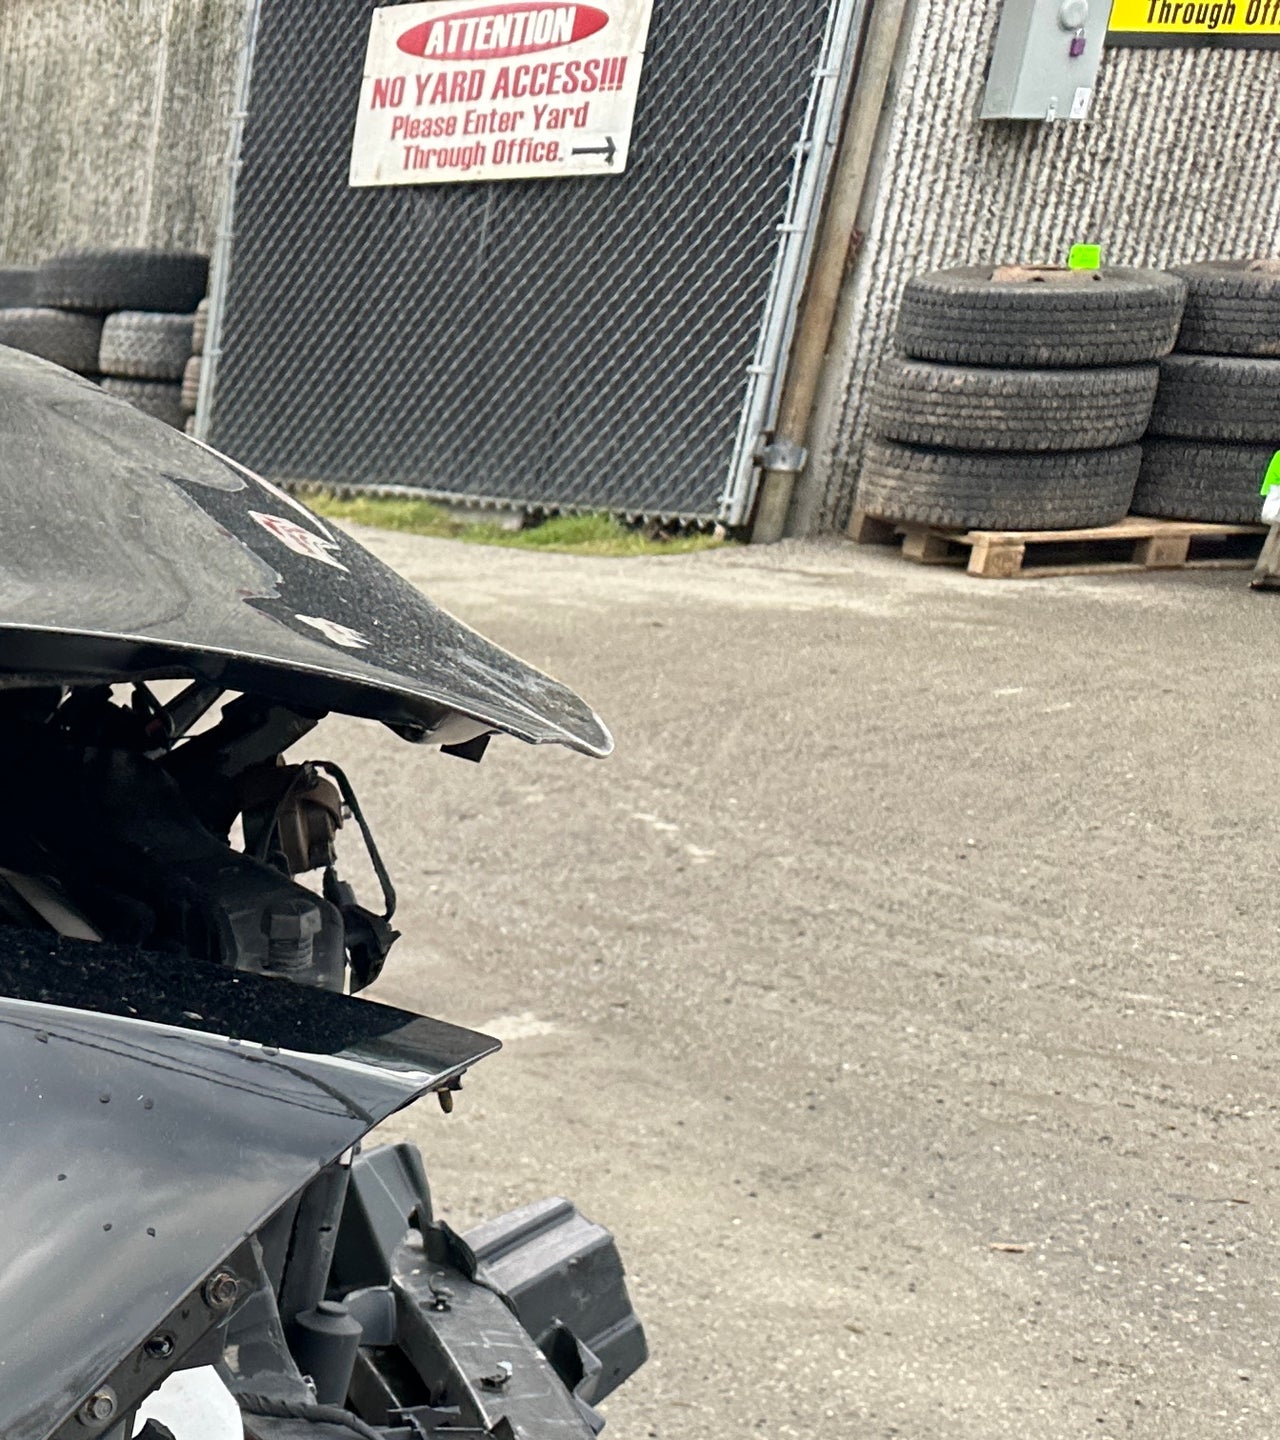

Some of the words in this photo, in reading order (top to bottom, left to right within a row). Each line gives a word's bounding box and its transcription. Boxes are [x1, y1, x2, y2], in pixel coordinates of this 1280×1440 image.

[424, 6, 577, 56] ATTENTION
[1147, 0, 1236, 29] Through
[1245, 0, 1280, 25] Off
[370, 76, 406, 109] NO
[415, 69, 486, 106] YARD
[491, 56, 628, 100] ACCESS!!!
[390, 114, 457, 140] Please
[463, 109, 525, 135] Enter
[533, 102, 590, 129] Yard
[403, 143, 486, 171] Through
[492, 137, 564, 165] Office.
